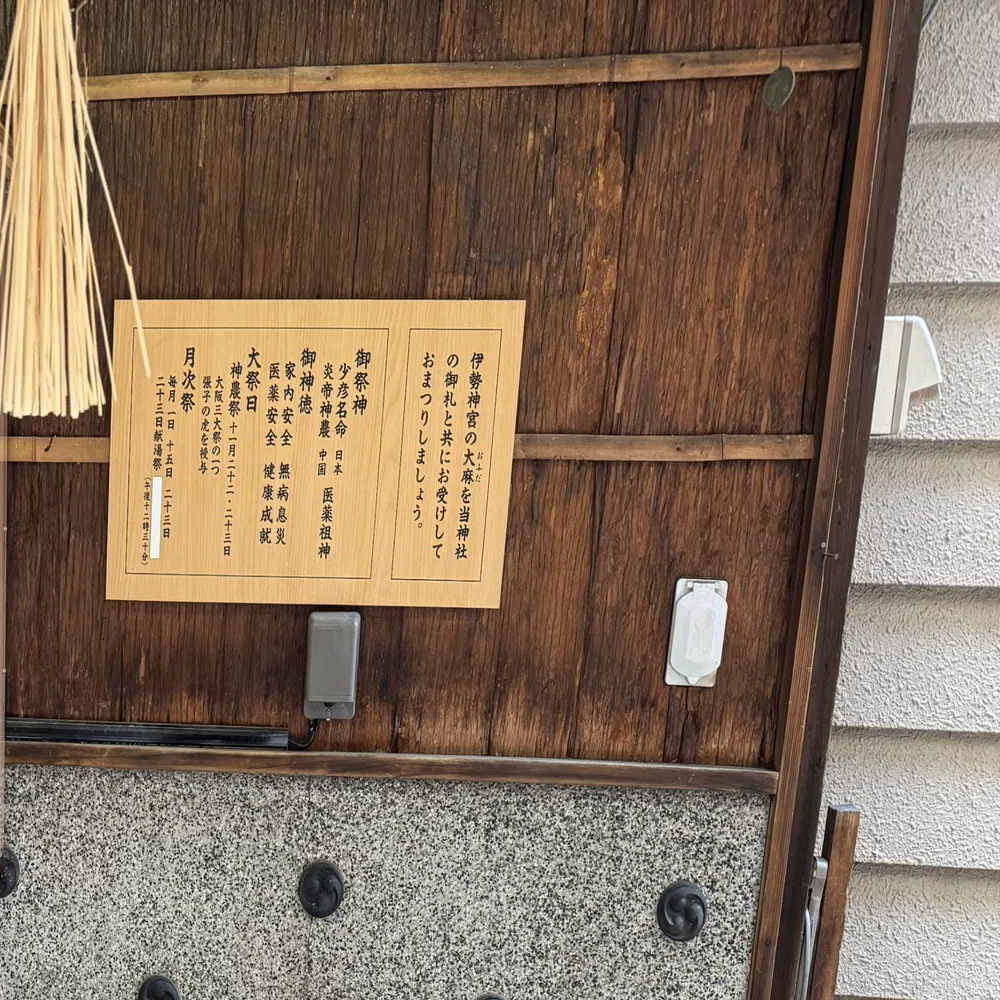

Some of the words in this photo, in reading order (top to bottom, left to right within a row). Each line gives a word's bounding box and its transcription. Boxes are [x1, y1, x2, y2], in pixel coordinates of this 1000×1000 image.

[168, 375, 177, 402] 毎月
[181, 347, 195, 413] 月次祭
[228, 362, 242, 417] 神農祭
[245, 347, 261, 412] 大祭日
[265, 363, 280, 446] 医薬安全
[281, 361, 296, 446] 家内安全
[298, 348, 316, 414] 御神徳
[318, 363, 333, 438] 炎帝神農
[335, 363, 351, 438] 少彦名命
[352, 348, 371, 415] 御祭神
[153, 377, 165, 471] 二十三日献湯祭
[168, 412, 176, 429] 一日
[199, 376, 212, 474] 張子の虎を授与
[211, 376, 224, 474] 大阪三大祭の一つ
[413, 352, 434, 528] おまつりしましょう。
[433, 354, 459, 558] の御札と共にお受けして
[455, 352, 484, 559] 伊勢神宮の大麻を当神社
[166, 441, 174, 477] 十五日
[318, 449, 327, 475] 中国
[334, 450, 342, 475] 日本
[475, 452, 483, 482] おふだ
[163, 490, 172, 538] 二十三日
[260, 462, 275, 544] 健康成就
[276, 462, 290, 545] 無病息災
[318, 487, 333, 559] 医薬祖神
